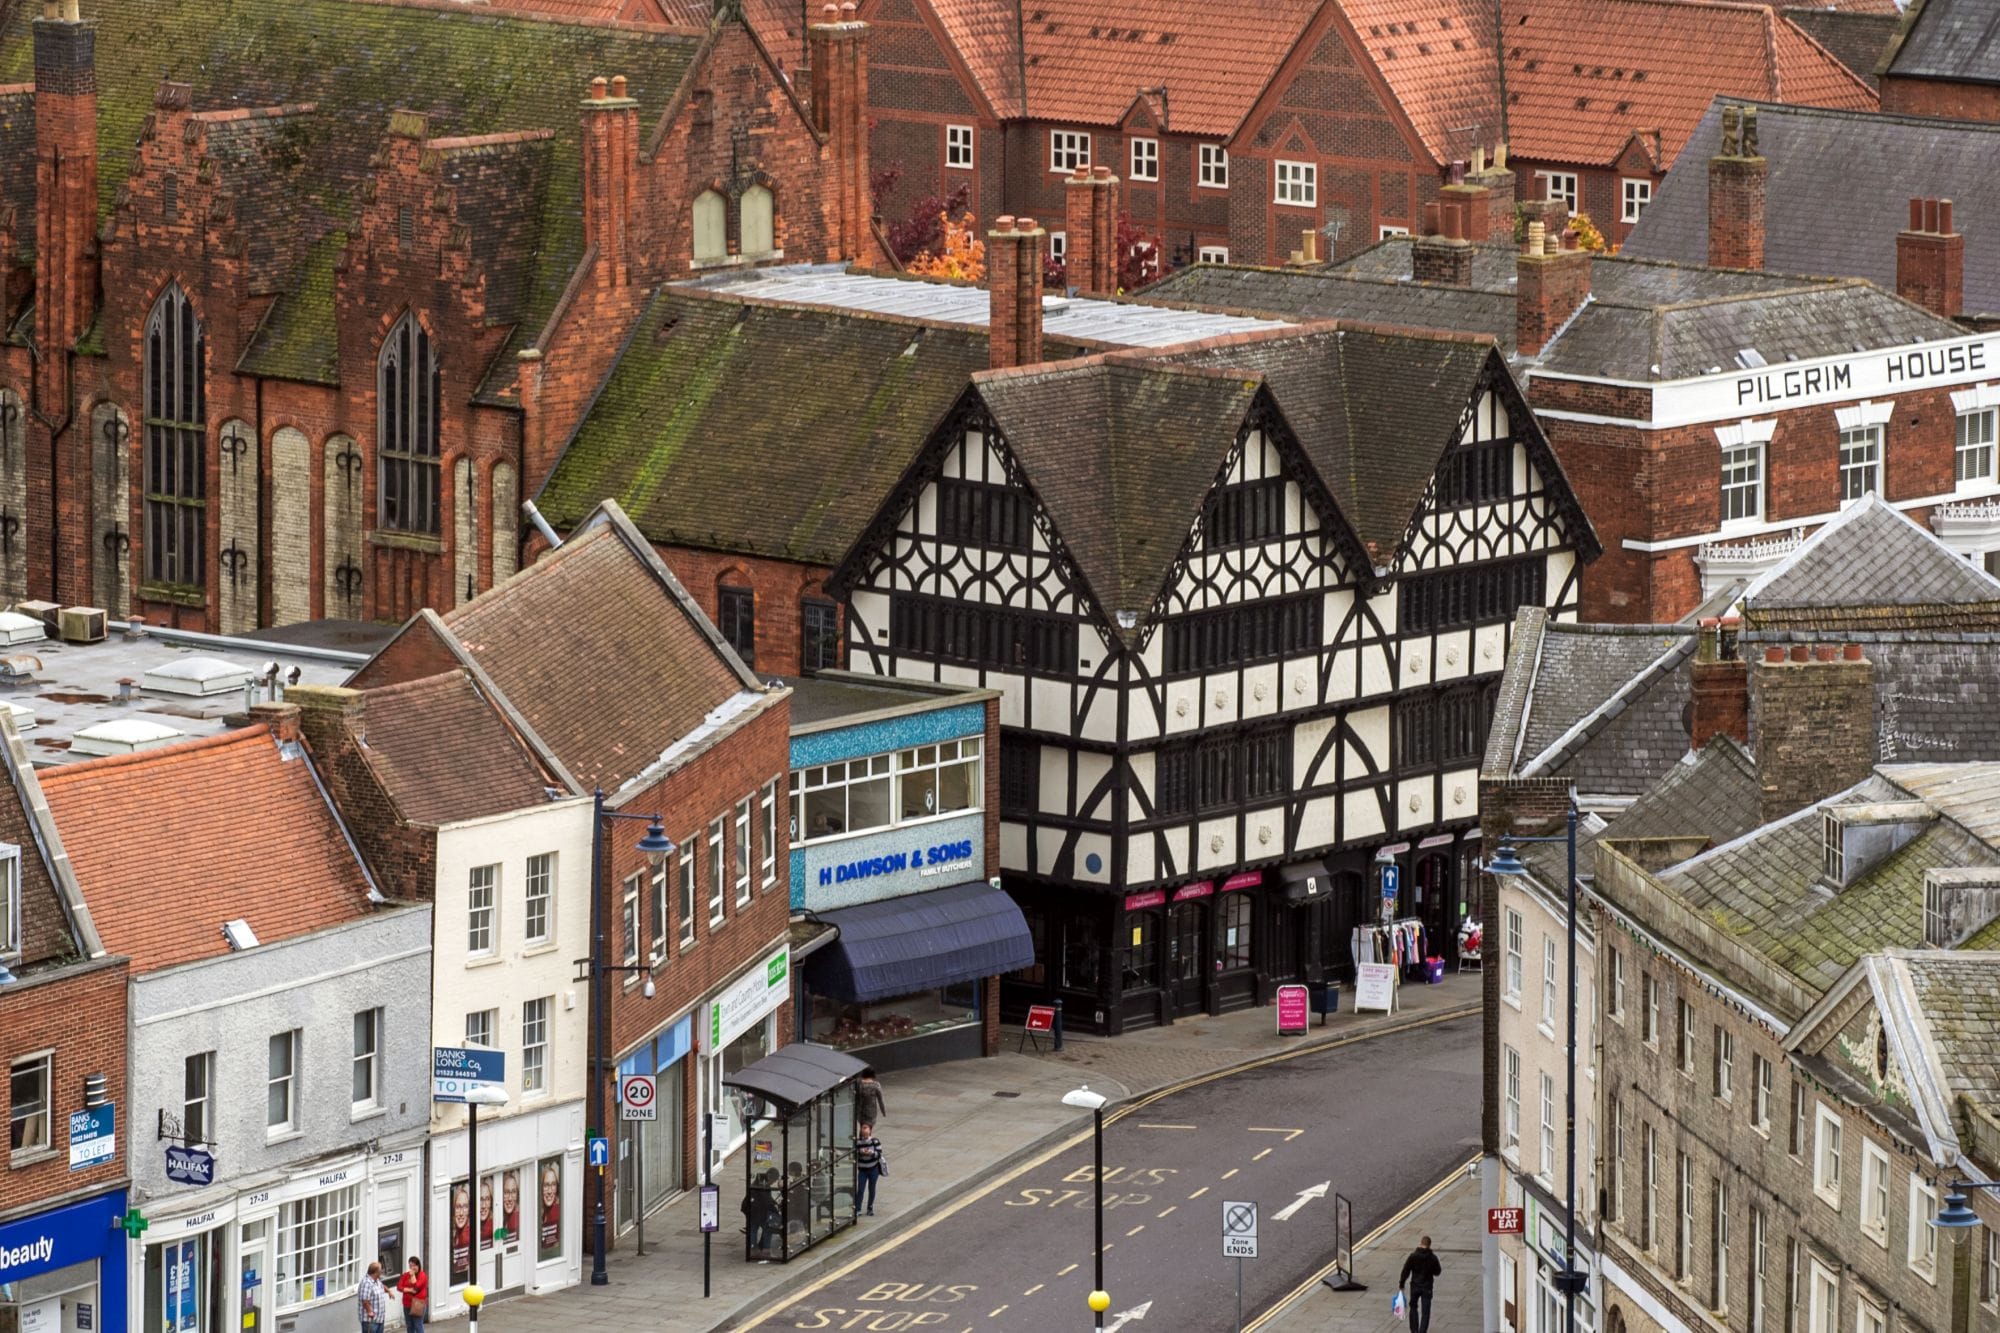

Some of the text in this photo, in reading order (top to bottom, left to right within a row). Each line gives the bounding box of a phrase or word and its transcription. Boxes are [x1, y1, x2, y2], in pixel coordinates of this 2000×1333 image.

[1737, 343, 1986, 405] PILGRIM HOUSE
[819, 839, 973, 886] H DAWSON & SONS
[920, 860, 973, 877] FAMILY BUTCHERS
[436, 1050, 466, 1060] BANKS
[436, 1080, 457, 1092] TO
[629, 1086, 650, 1099] 20
[71, 1112, 90, 1125] BANKS
[626, 1109, 653, 1117] ZONE
[80, 1148, 90, 1160] TO
[92, 1143, 106, 1156] LET
[168, 1159, 209, 1173] HALIFAX
[319, 1171, 347, 1186] HALIFAX
[1061, 1165, 1179, 1185] BUS
[1004, 1188, 1152, 1210] STOP
[186, 1212, 216, 1228] HALIFAX
[1492, 1210, 1518, 1219] JUST
[1498, 1219, 1518, 1229] EAT
[0, 1235, 54, 1270] beauty
[1226, 1246, 1254, 1254] ENDS
[857, 1282, 979, 1302] BUS
[795, 1308, 950, 1331] STOP
